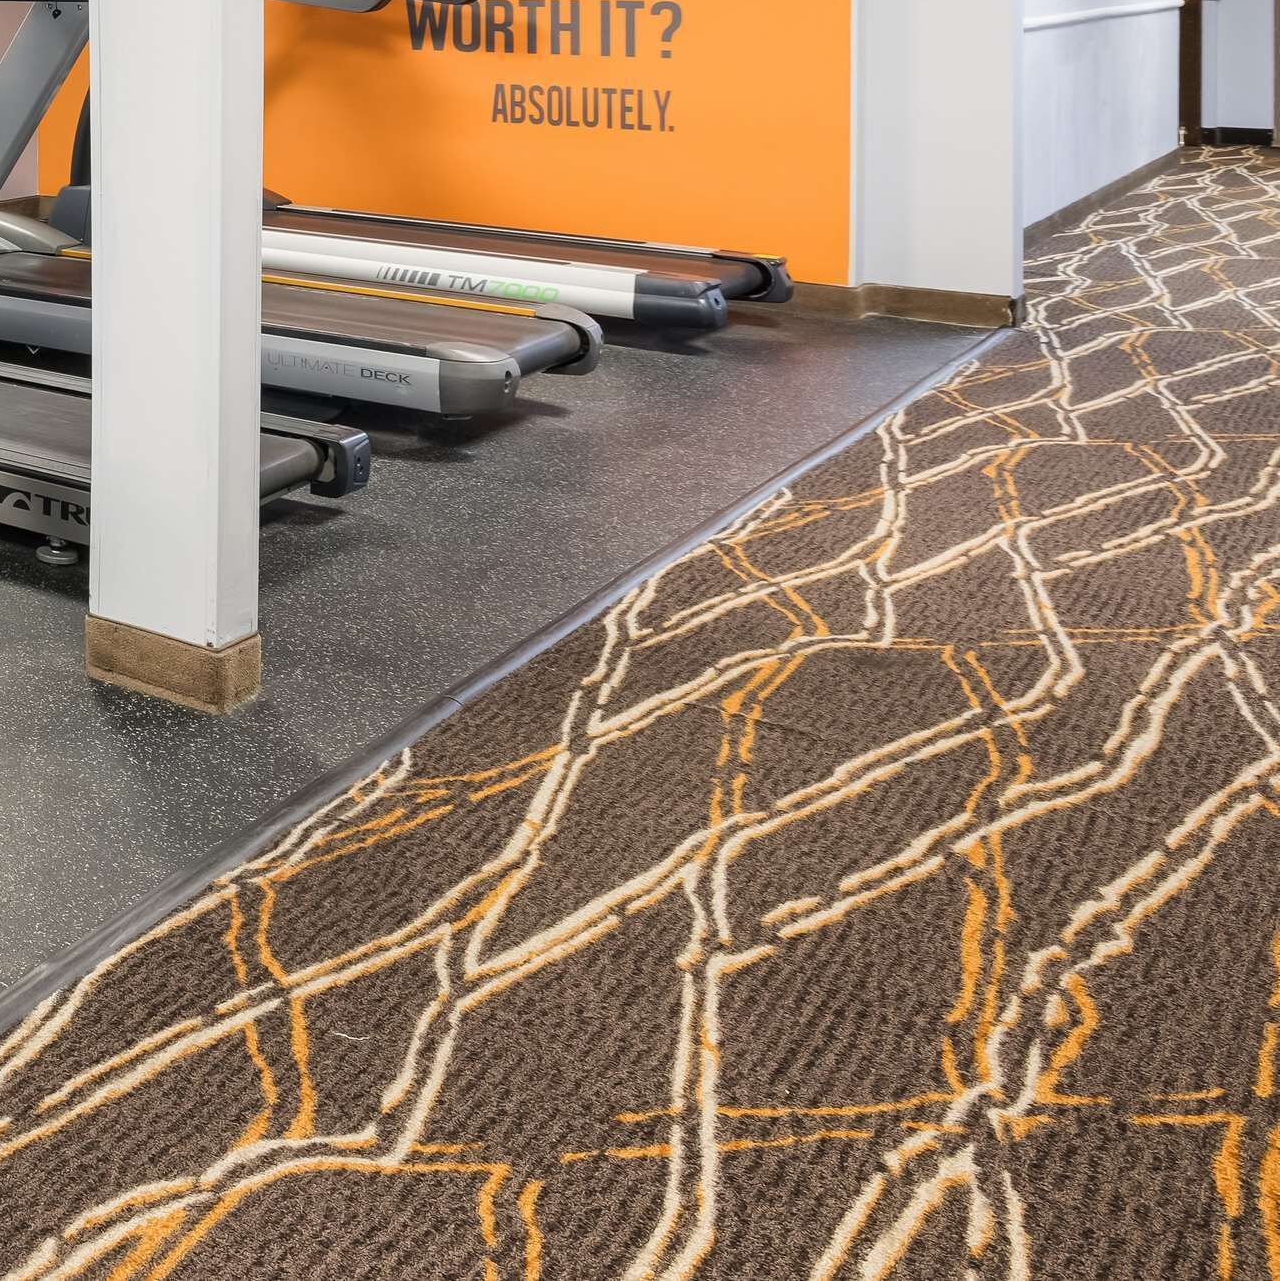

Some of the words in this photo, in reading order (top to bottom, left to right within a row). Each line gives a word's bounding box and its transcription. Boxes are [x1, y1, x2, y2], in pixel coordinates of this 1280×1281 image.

[599, 0, 683, 59] IT?
[491, 82, 676, 133] ABSOLUTELY.
[448, 274, 561, 303] TM7000
[266, 349, 357, 379] ULTIMATE
[360, 368, 412, 386] DECK
